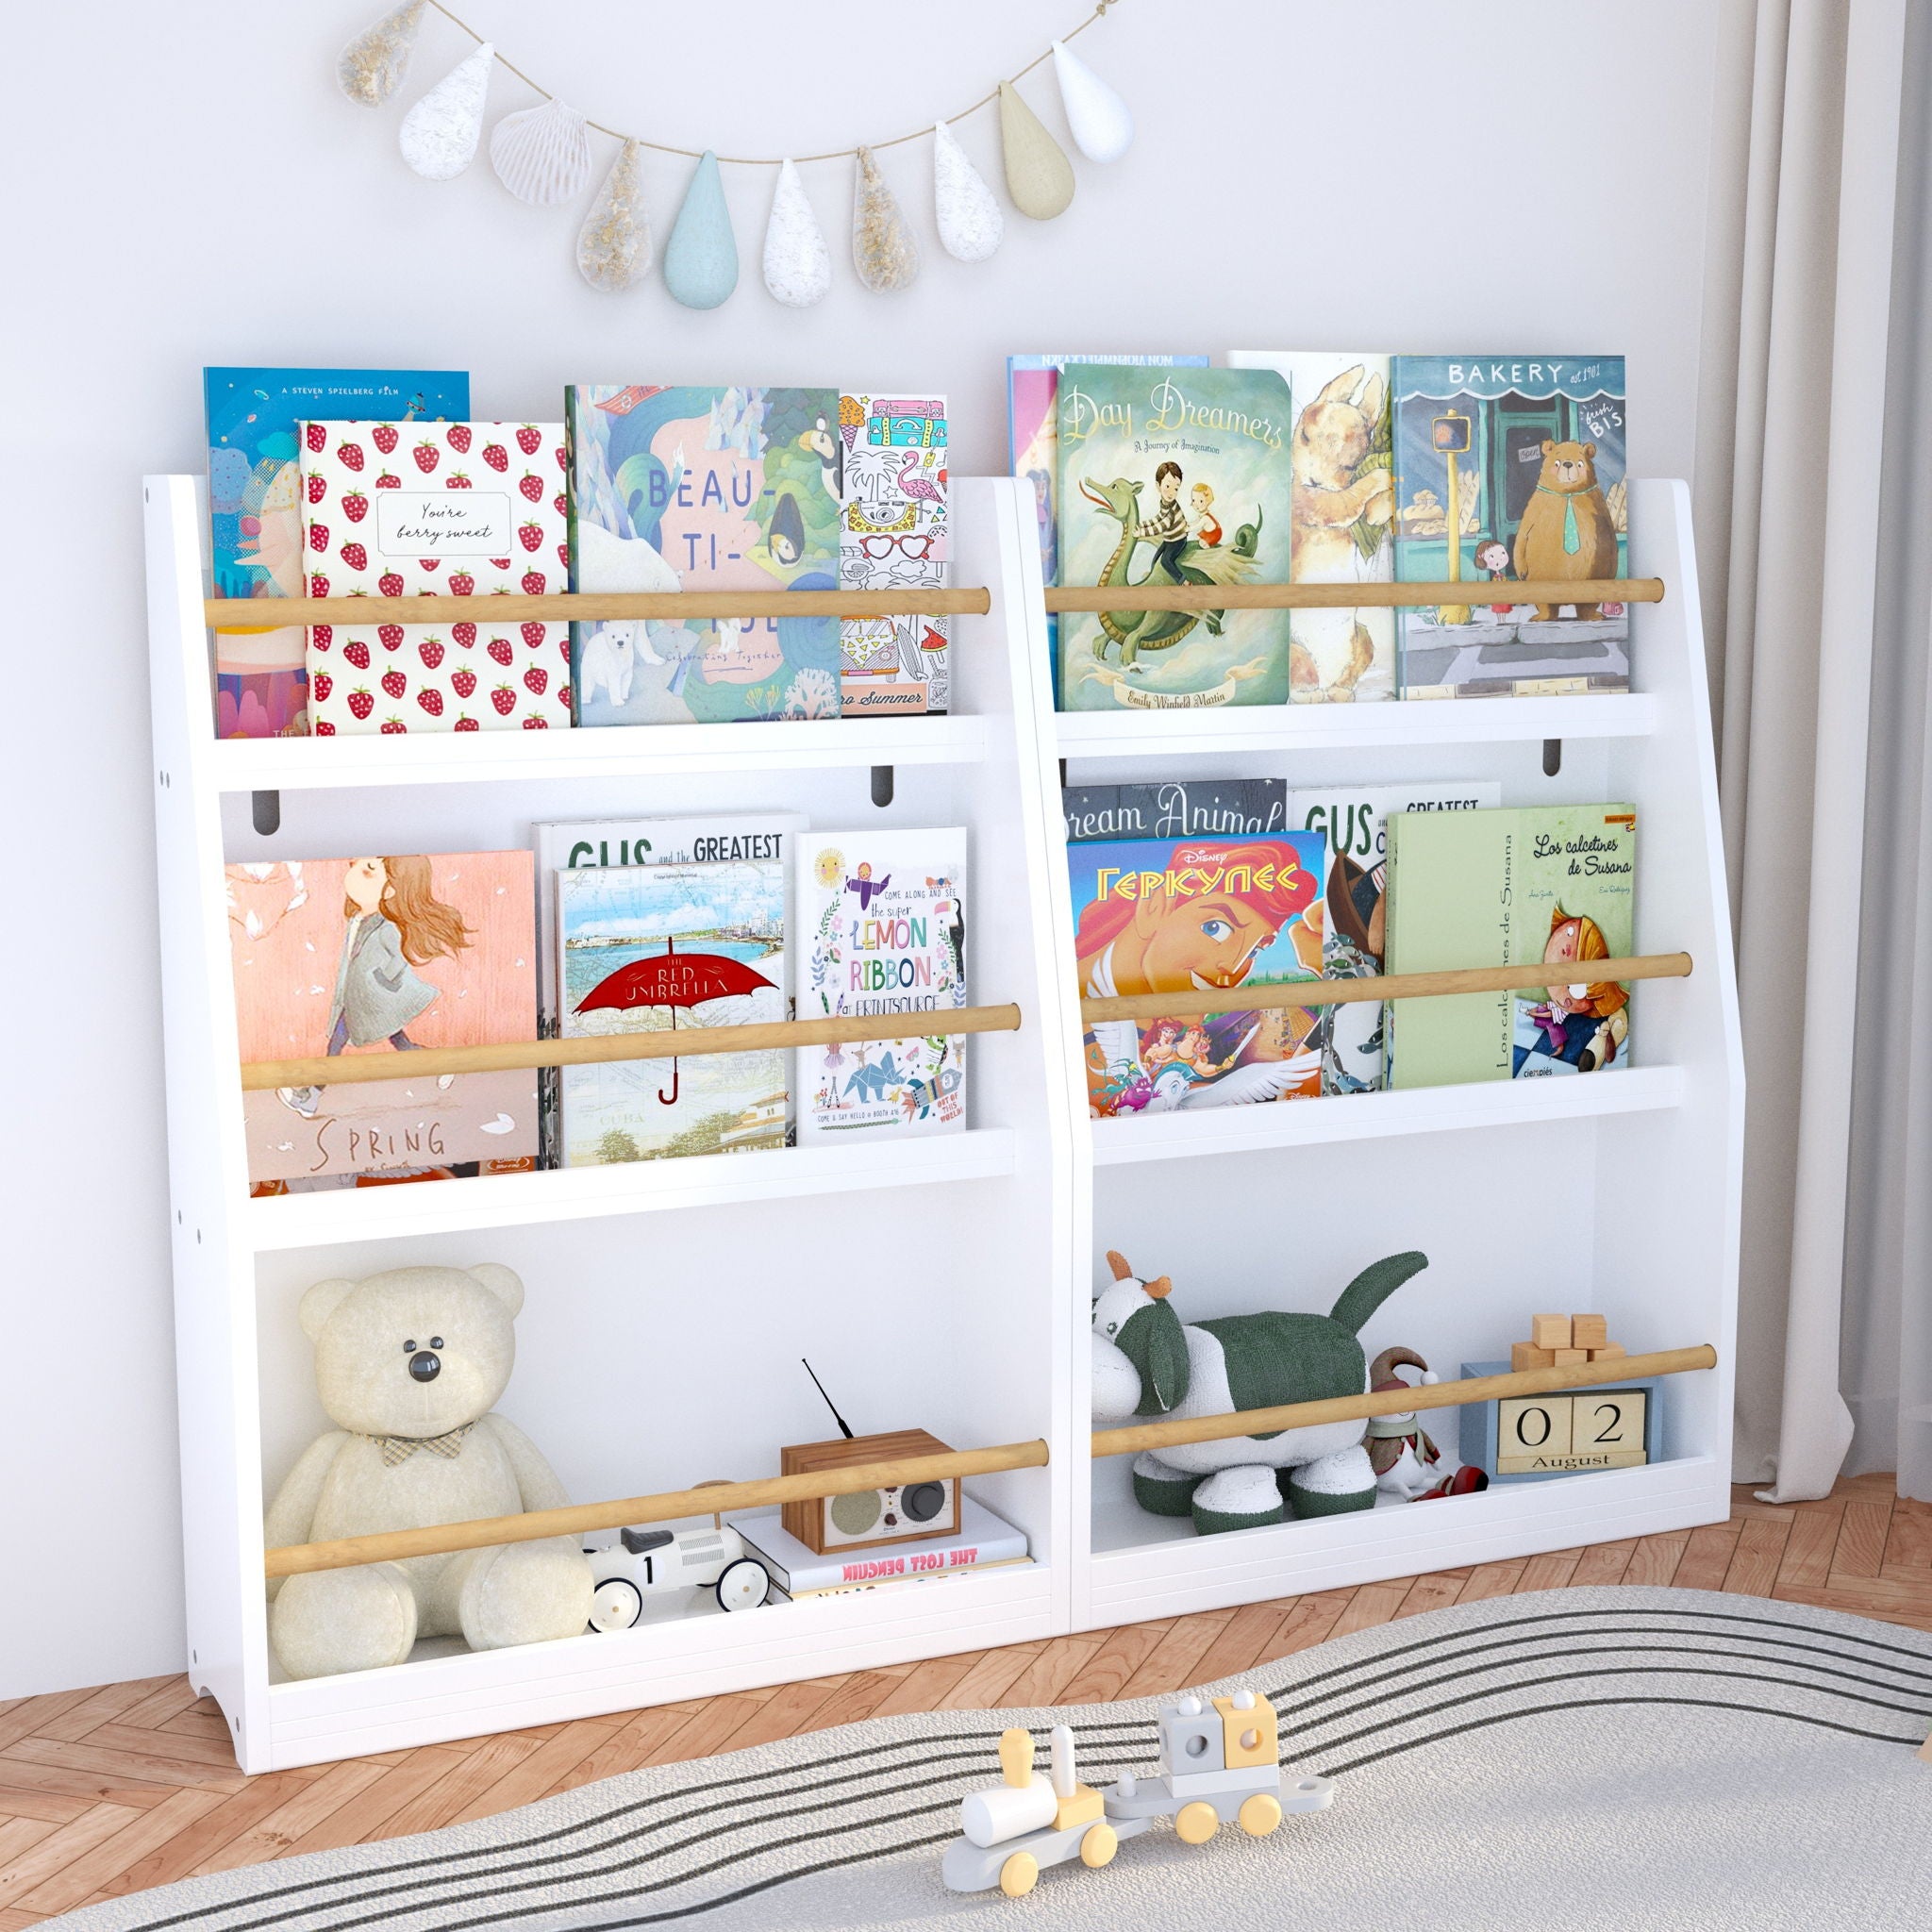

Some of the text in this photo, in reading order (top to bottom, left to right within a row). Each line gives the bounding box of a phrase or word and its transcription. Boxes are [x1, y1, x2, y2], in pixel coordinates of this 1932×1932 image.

[1448, 363, 1562, 384] BAKERY
[1063, 375, 1284, 450] Day Dreamers
[1134, 439, 1221, 454] A Journey of Imagination
[649, 469, 776, 508] BEAU-
[422, 502, 468, 520] You're
[396, 525, 492, 545] berry sweet
[682, 533, 741, 571] TI-
[858, 691, 924, 706] Summer
[1127, 691, 1151, 709] Emily
[1194, 691, 1225, 708] Martin
[1063, 783, 1285, 842] ream Animal
[1305, 803, 1374, 856] GUS
[693, 834, 782, 862] GREATEST
[1181, 850, 1228, 864] Disney
[1533, 834, 1618, 858] Los calcetines
[1500, 834, 1513, 907] Susana
[1568, 856, 1632, 876] de Susana
[884, 888, 957, 901] COME ALONG AND SEE
[872, 903, 912, 919] the super
[849, 917, 927, 951] LEMON
[1499, 912, 1510, 934] de
[658, 967, 694, 983] RED
[850, 956, 931, 991] RIBBON
[625, 978, 728, 1001] UMBRELLA
[1496, 1032, 1509, 1069] Los
[309, 1119, 445, 1172] SPRING
[1531, 1454, 1610, 1471] August
[643, 1556, 653, 1585] 1
